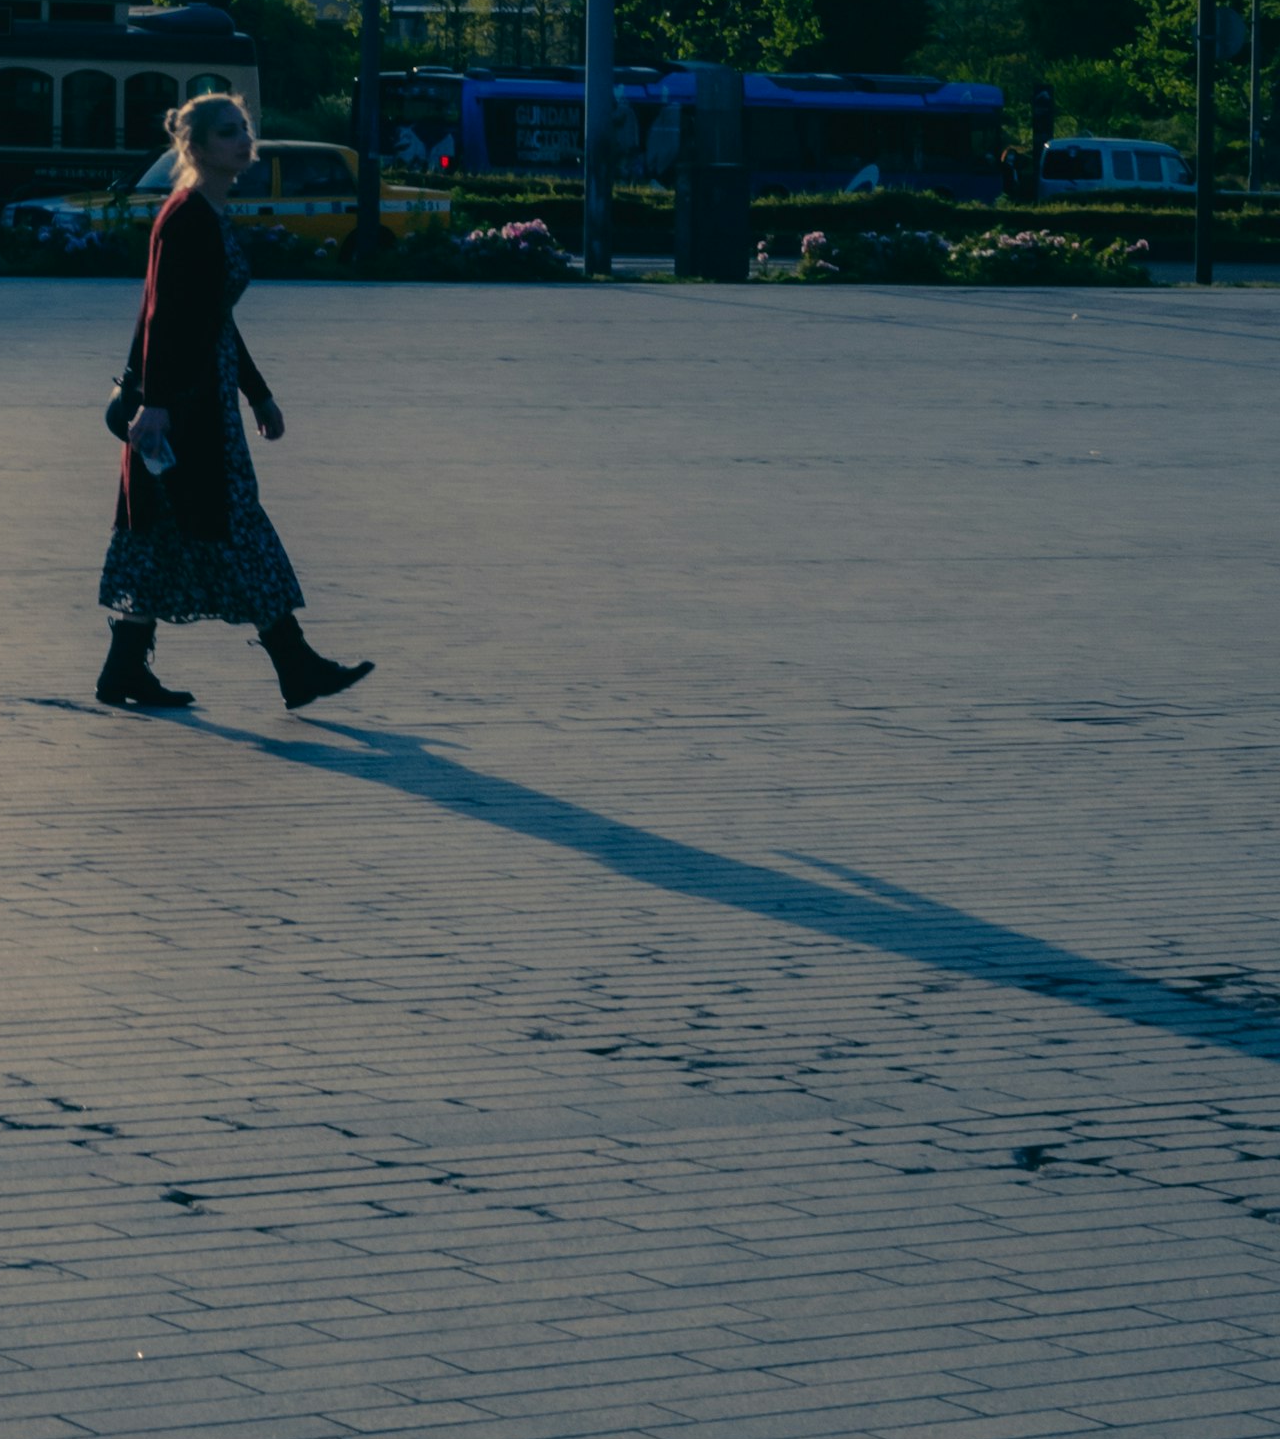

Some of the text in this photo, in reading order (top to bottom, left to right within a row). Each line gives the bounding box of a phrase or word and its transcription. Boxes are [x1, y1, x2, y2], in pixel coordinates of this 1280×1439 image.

[515, 104, 581, 126] GUNDAM
[516, 129, 581, 149] FACTORY
[223, 201, 250, 215] AXI
